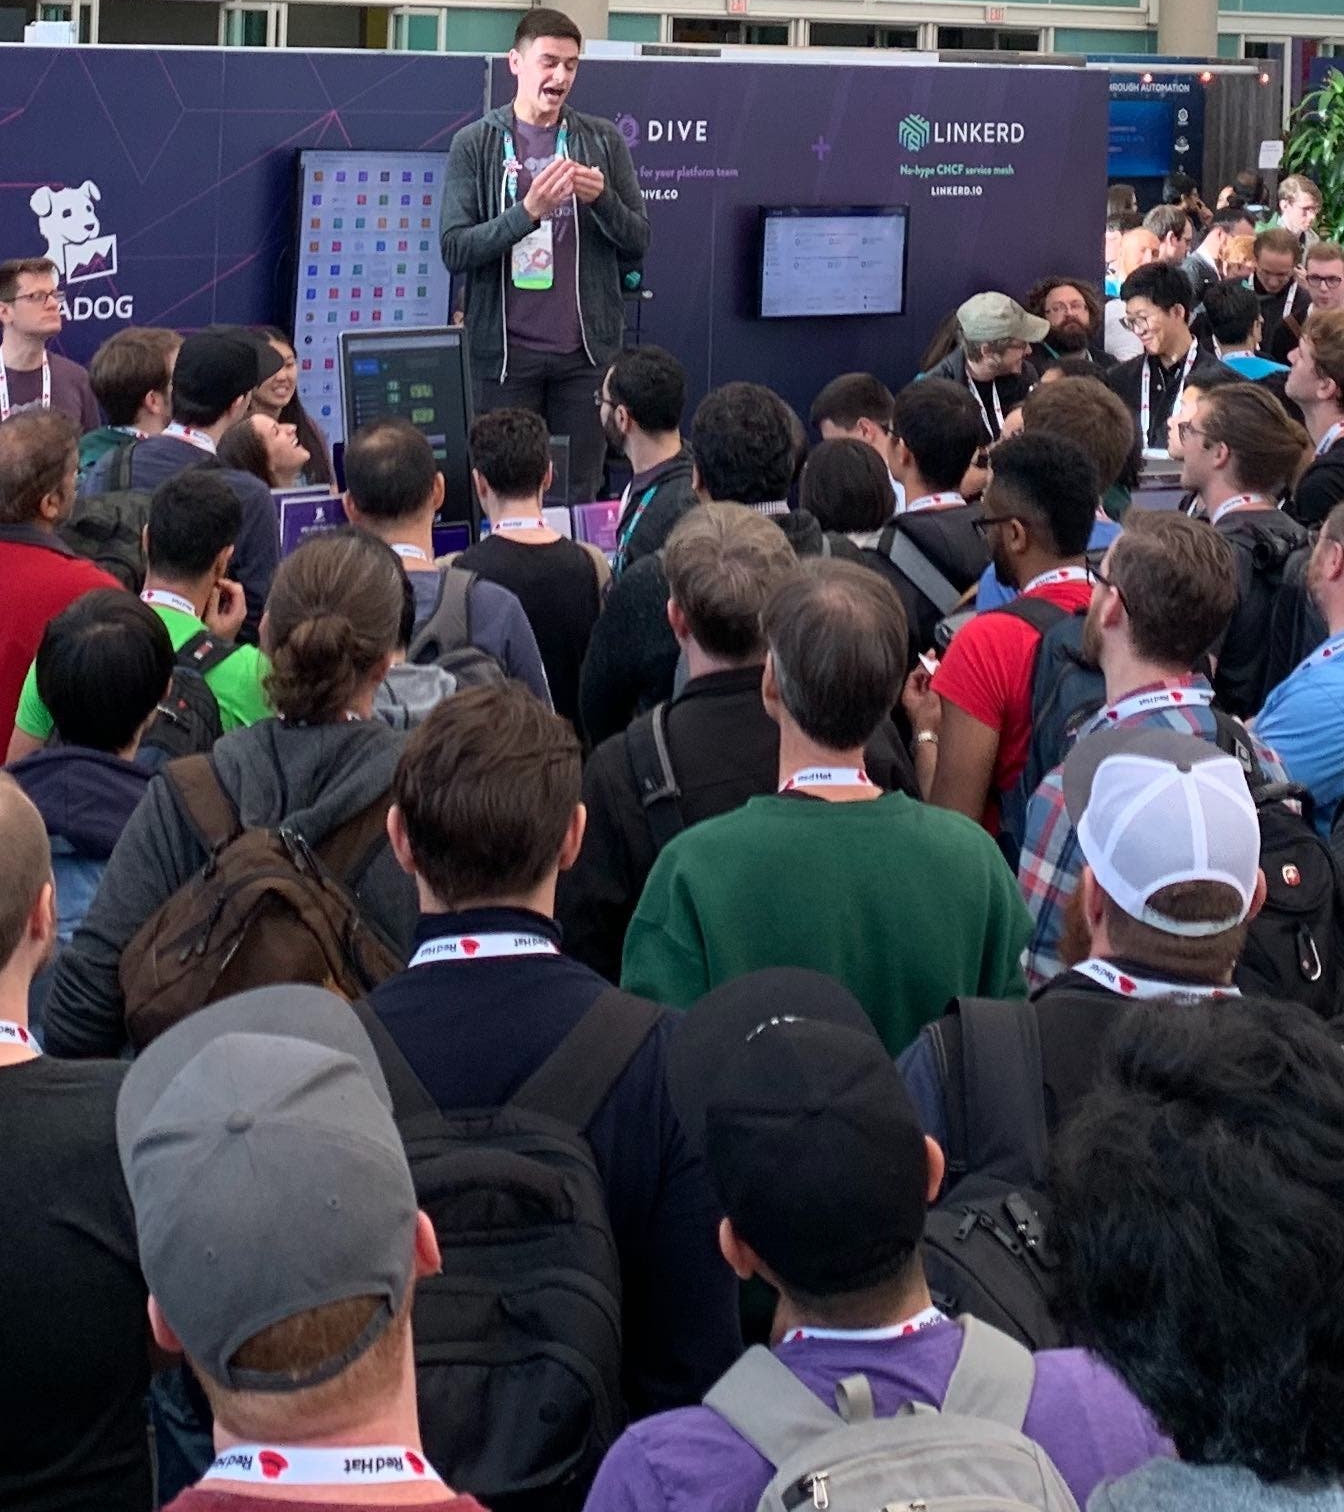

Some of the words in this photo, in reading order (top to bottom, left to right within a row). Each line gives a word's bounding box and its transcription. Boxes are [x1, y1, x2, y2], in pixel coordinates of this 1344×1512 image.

[1141, 84, 1190, 92] AUTOMATION
[648, 120, 707, 142] DIVE
[934, 122, 1024, 143] LINKERD
[640, 165, 653, 177] for
[655, 168, 675, 180] your
[677, 165, 715, 181] platform
[717, 167, 739, 177] team
[931, 186, 983, 196] LINKERD.IO
[57, 296, 134, 320] ADOG
[815, 772, 832, 781] Hat
[226, 1455, 253, 1470] Red
[344, 1458, 372, 1473] Hat
[375, 1456, 403, 1473] Red
